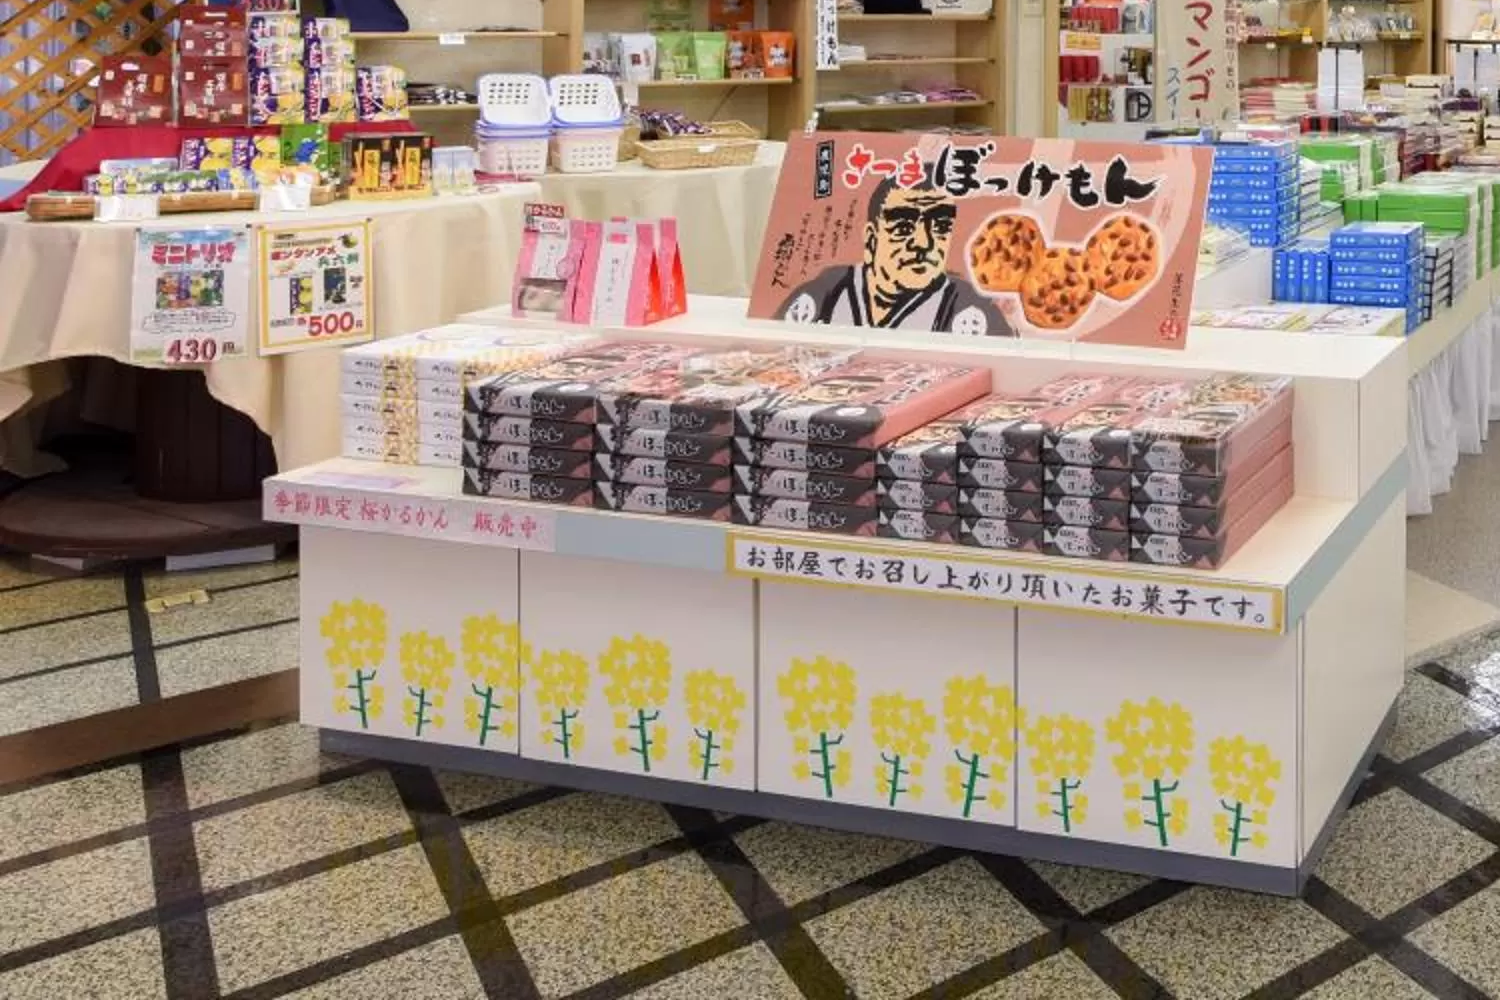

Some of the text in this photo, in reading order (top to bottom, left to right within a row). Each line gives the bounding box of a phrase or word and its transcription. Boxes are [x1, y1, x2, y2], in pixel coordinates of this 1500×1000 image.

[842, 143, 1158, 208] さつまぼっけもん
[151, 241, 237, 265] ミニトリオ
[273, 489, 537, 539] 季節限定 桜かるかん 販売中
[746, 544, 1267, 626] お部屋でお召し上がり頂いたお菓子です。
